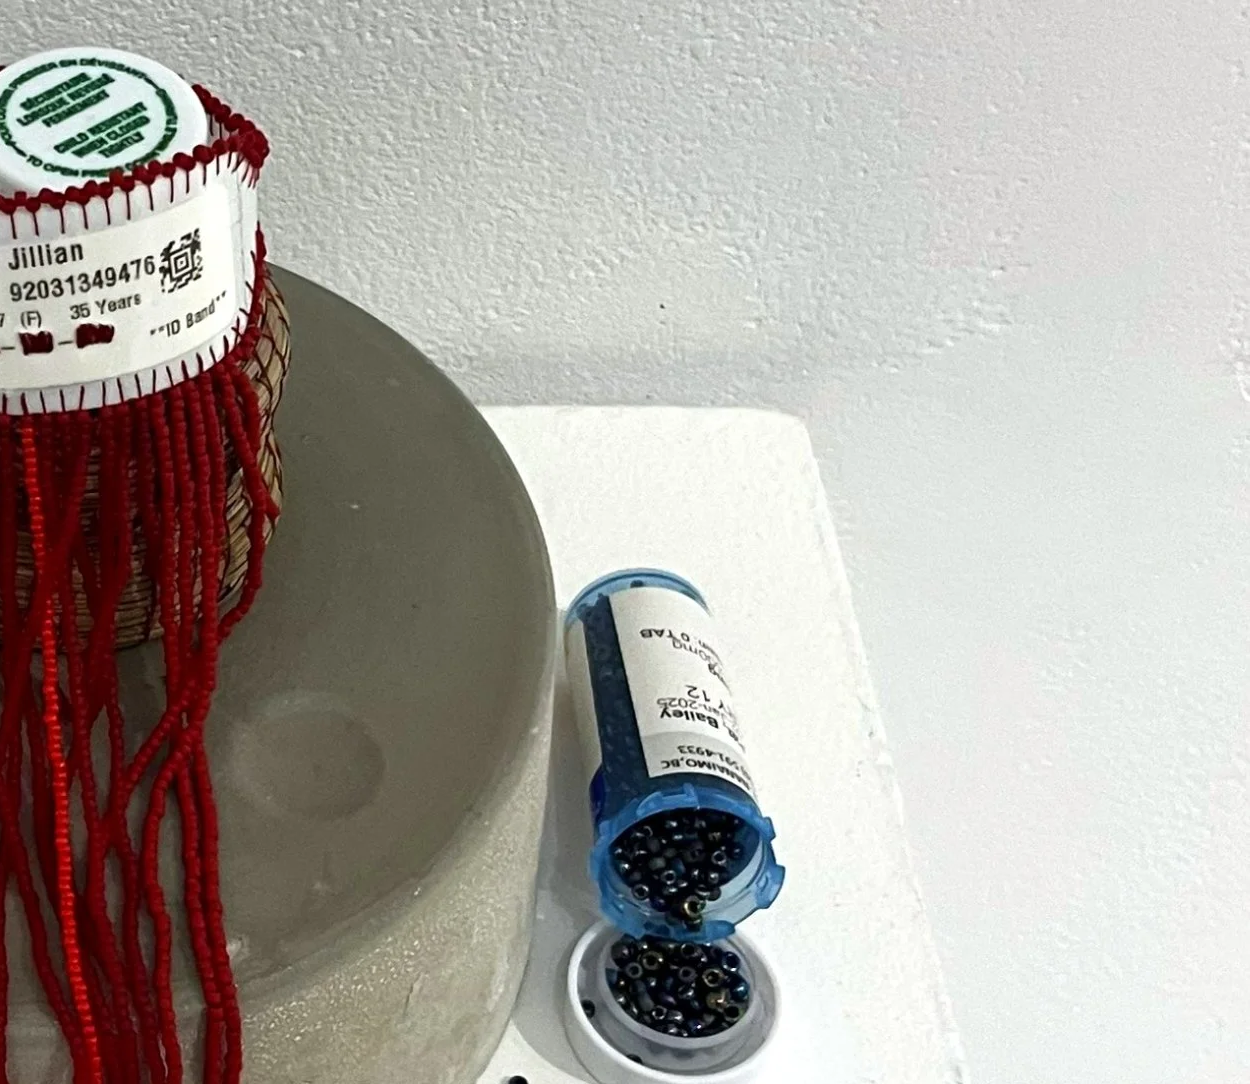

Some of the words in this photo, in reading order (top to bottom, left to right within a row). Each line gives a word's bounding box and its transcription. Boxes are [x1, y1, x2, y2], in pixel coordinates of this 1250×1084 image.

[8, 243, 84, 271] Jillian
[10, 255, 155, 302] 92031349476
[20, 310, 42, 329] (F)
[70, 303, 90, 320] 35
[95, 292, 142, 316] Years
[660, 704, 719, 729] Bailey
